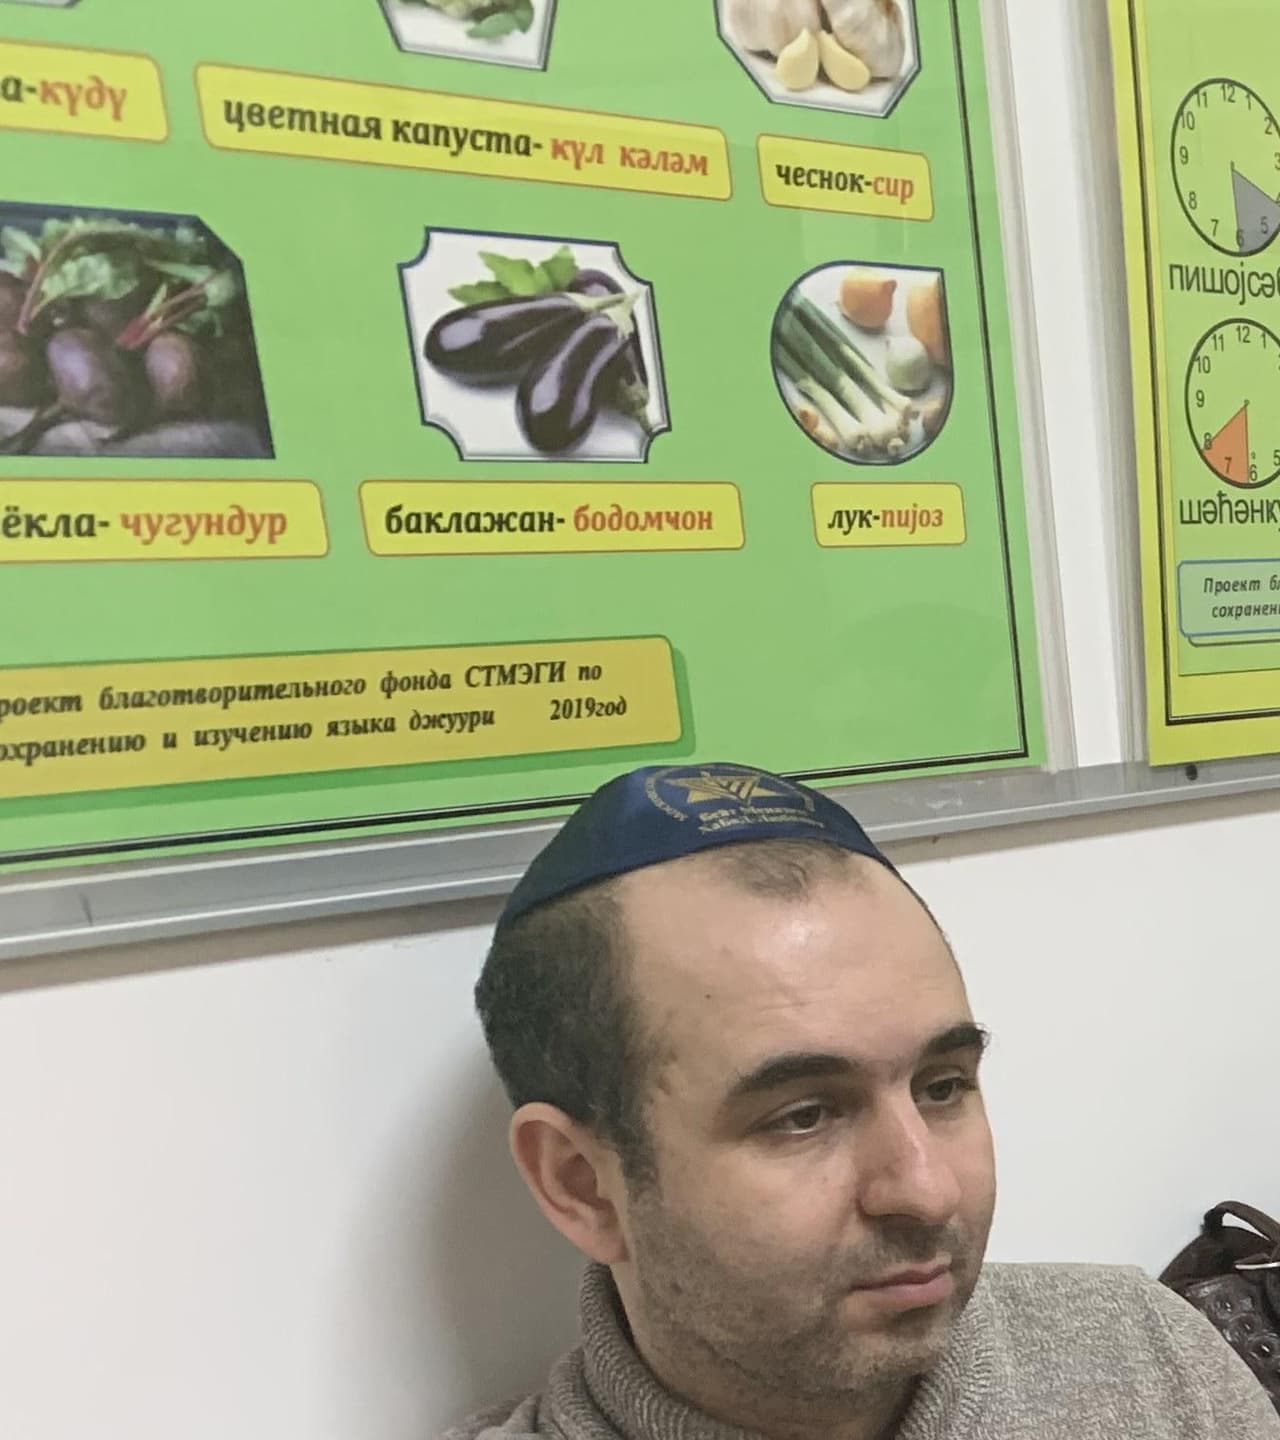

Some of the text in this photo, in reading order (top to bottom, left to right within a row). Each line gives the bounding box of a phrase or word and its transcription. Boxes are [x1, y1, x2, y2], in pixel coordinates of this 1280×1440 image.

[1196, 90, 1208, 109] 11
[1220, 84, 1236, 103] 12
[1246, 92, 1252, 111] 1
[223, 98, 382, 139] цветная
[392, 118, 543, 158] капуста-
[1181, 110, 1195, 131] 10
[1264, 116, 1273, 135] 2
[1179, 146, 1188, 165] 9
[775, 162, 915, 205] чеснок-сир
[1188, 191, 1197, 211] 8
[1211, 219, 1219, 237] 7
[1260, 216, 1269, 235] 5
[1236, 229, 1245, 249] 6
[1211, 332, 1224, 352] 11
[1236, 324, 1250, 344] 12
[1261, 330, 1267, 349] 1
[1195, 355, 1211, 375] 10
[1195, 389, 1204, 408] 9
[1203, 431, 1212, 451] 8
[1224, 456, 1232, 474] 7
[1273, 449, 1280, 467] 5
[1249, 464, 1258, 482] 6
[120, 504, 288, 545] чугундур
[385, 503, 714, 536] баклажан- бодомчон
[1203, 576, 1261, 597] Проект
[98, 676, 367, 712] благотворительного
[380, 669, 452, 699] фонда
[465, 661, 567, 688] СТМЭГИ
[578, 664, 602, 681] по
[162, 731, 178, 750] и
[194, 721, 313, 752] изучению
[326, 716, 396, 737] языка
[409, 709, 495, 735] джуури
[550, 697, 628, 721] 2019год
